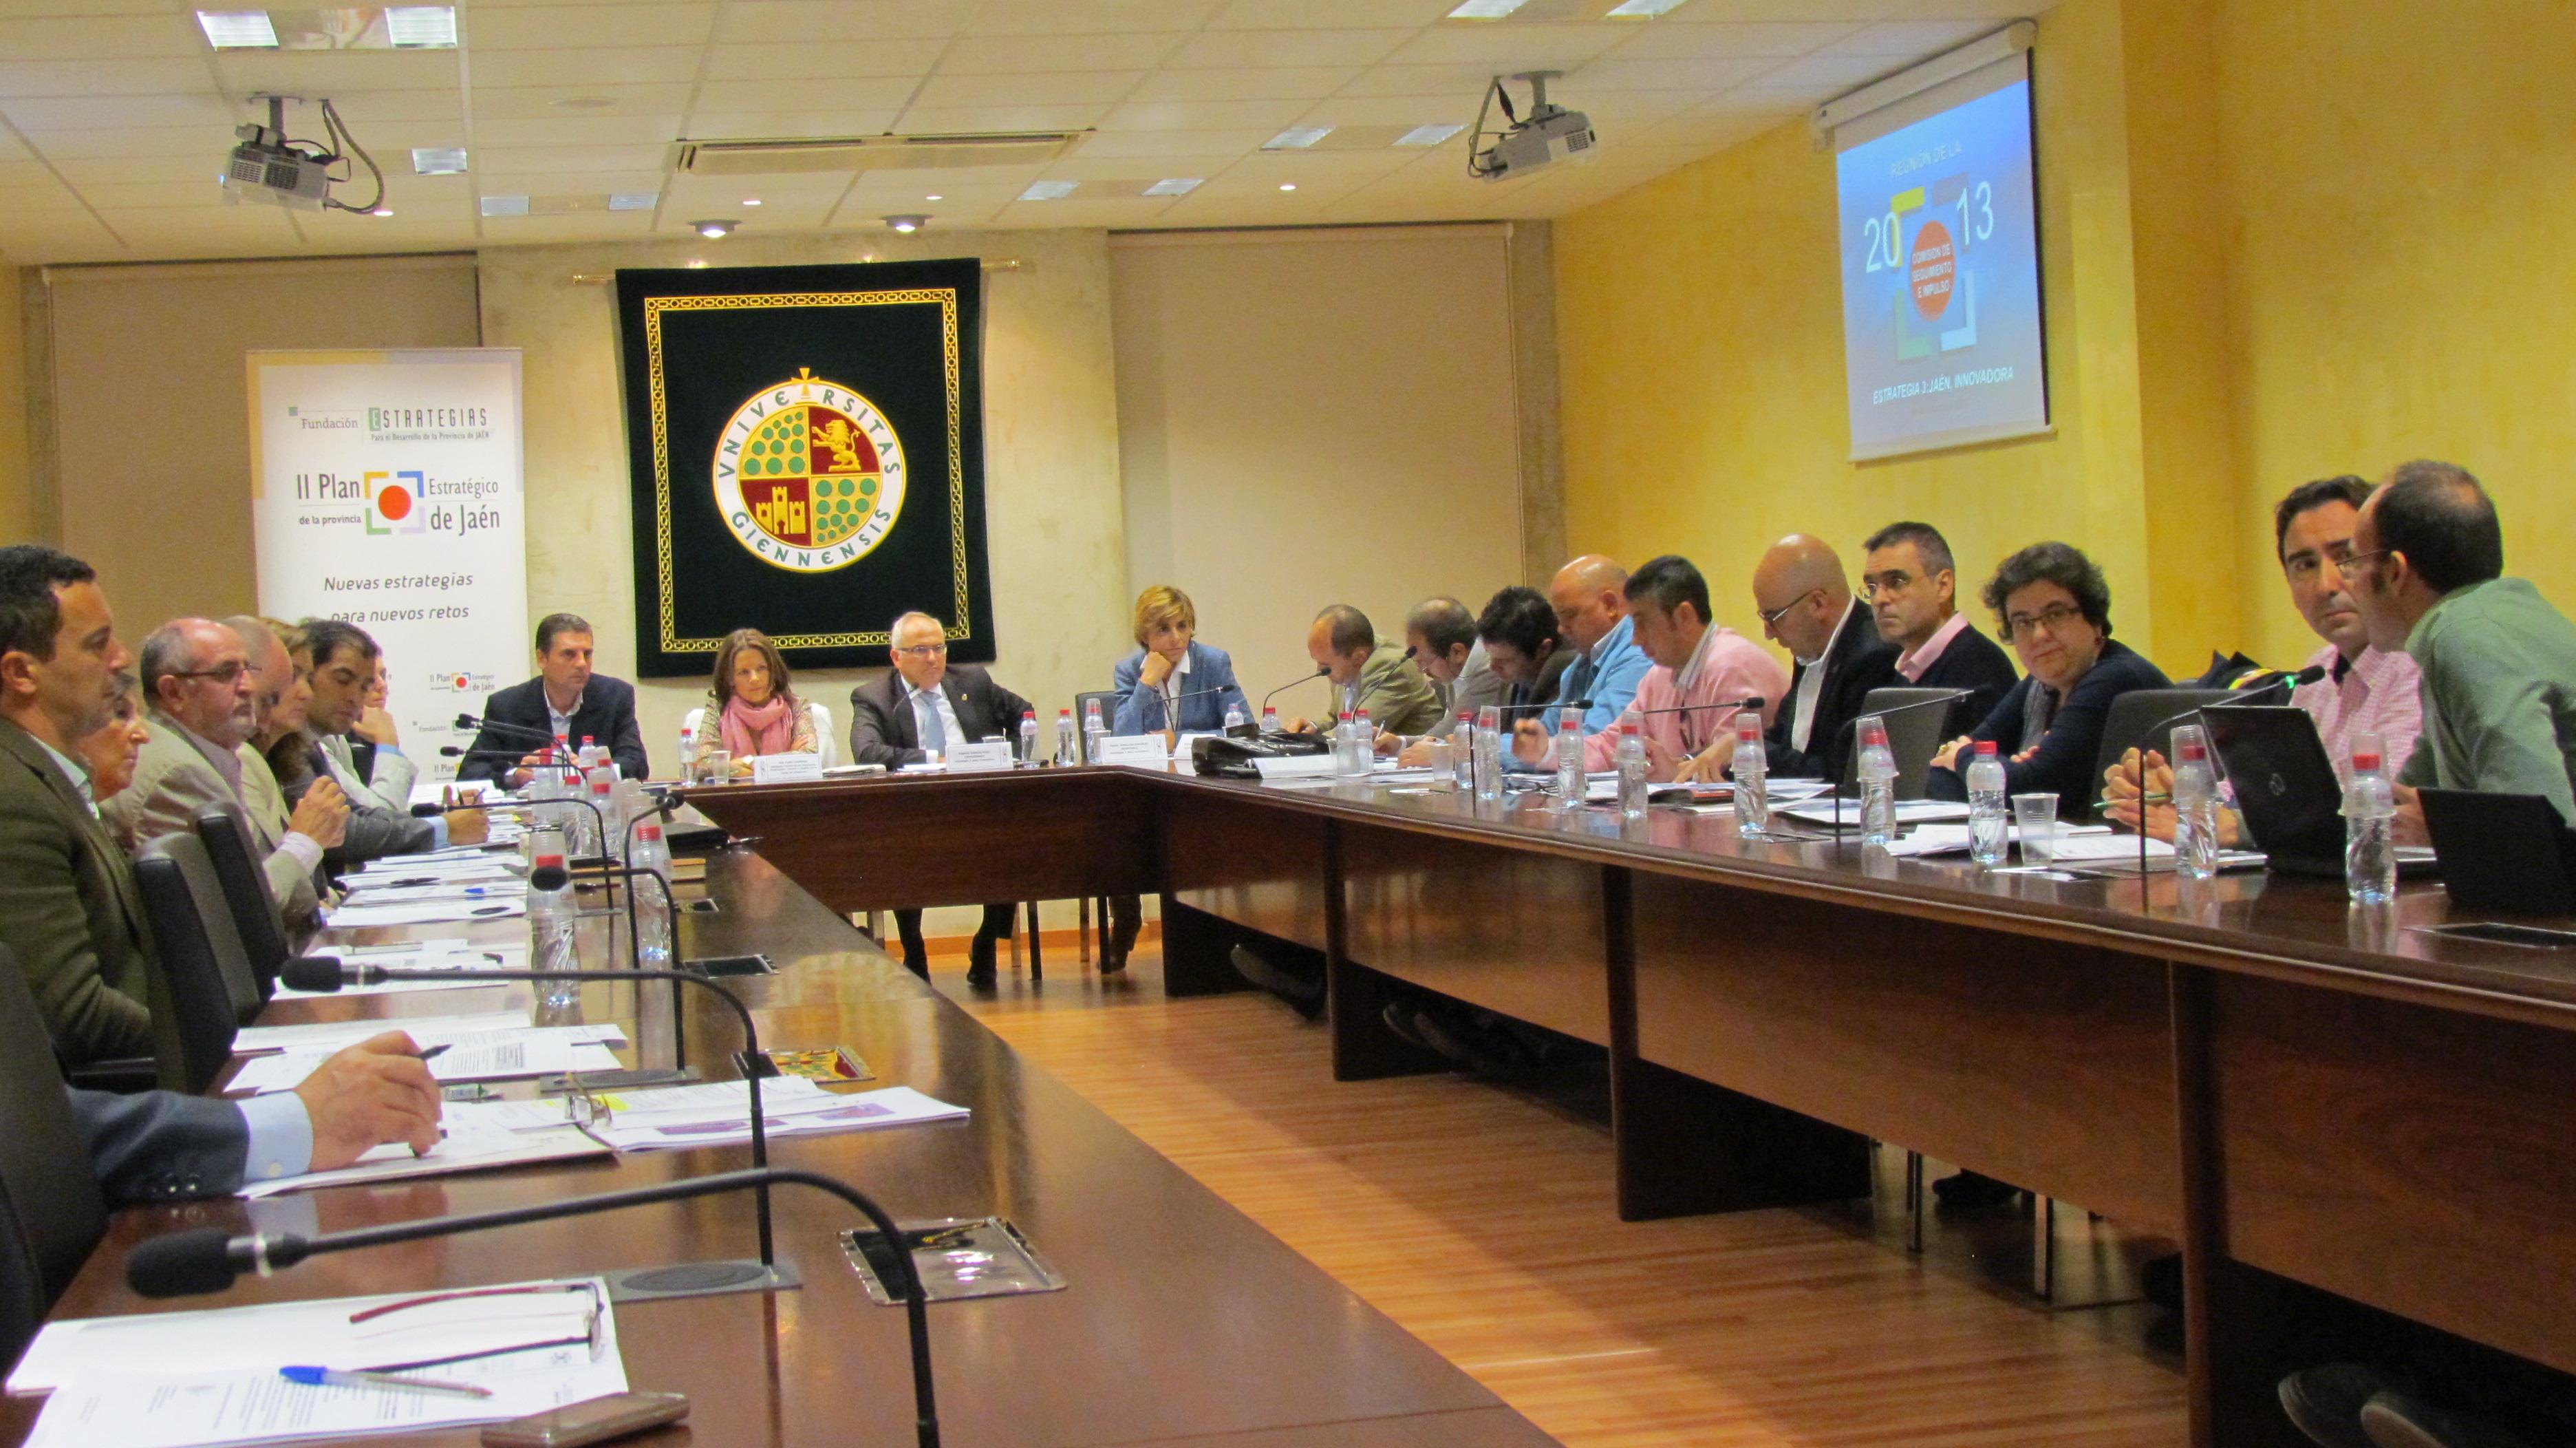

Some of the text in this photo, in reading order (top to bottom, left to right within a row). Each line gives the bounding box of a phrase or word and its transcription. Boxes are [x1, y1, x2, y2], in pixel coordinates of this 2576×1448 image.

[1864, 181, 1994, 273] 20 13
[1873, 381, 1920, 405] ESTRATEGIA
[1954, 366, 2014, 389] INNOVADORA
[301, 408, 487, 429] Fundación ESTRATEGIAS
[392, 433, 422, 441] Desarrollo
[423, 432, 431, 440] de
[431, 432, 438, 440] la
[439, 432, 466, 440] Provincia
[467, 432, 475, 440] de
[297, 473, 361, 500] II Plan
[429, 478, 499, 499] Estratégico
[299, 514, 362, 527] de la provincia
[430, 504, 500, 537] de Jaén
[731, 509, 891, 566] GIENNENSIS
[324, 572, 473, 592] Nuevas estrategias
[369, 608, 425, 622] nuevos
[429, 605, 470, 619] retos
[436, 673, 451, 683] Plan
[441, 763, 455, 773] Plan
